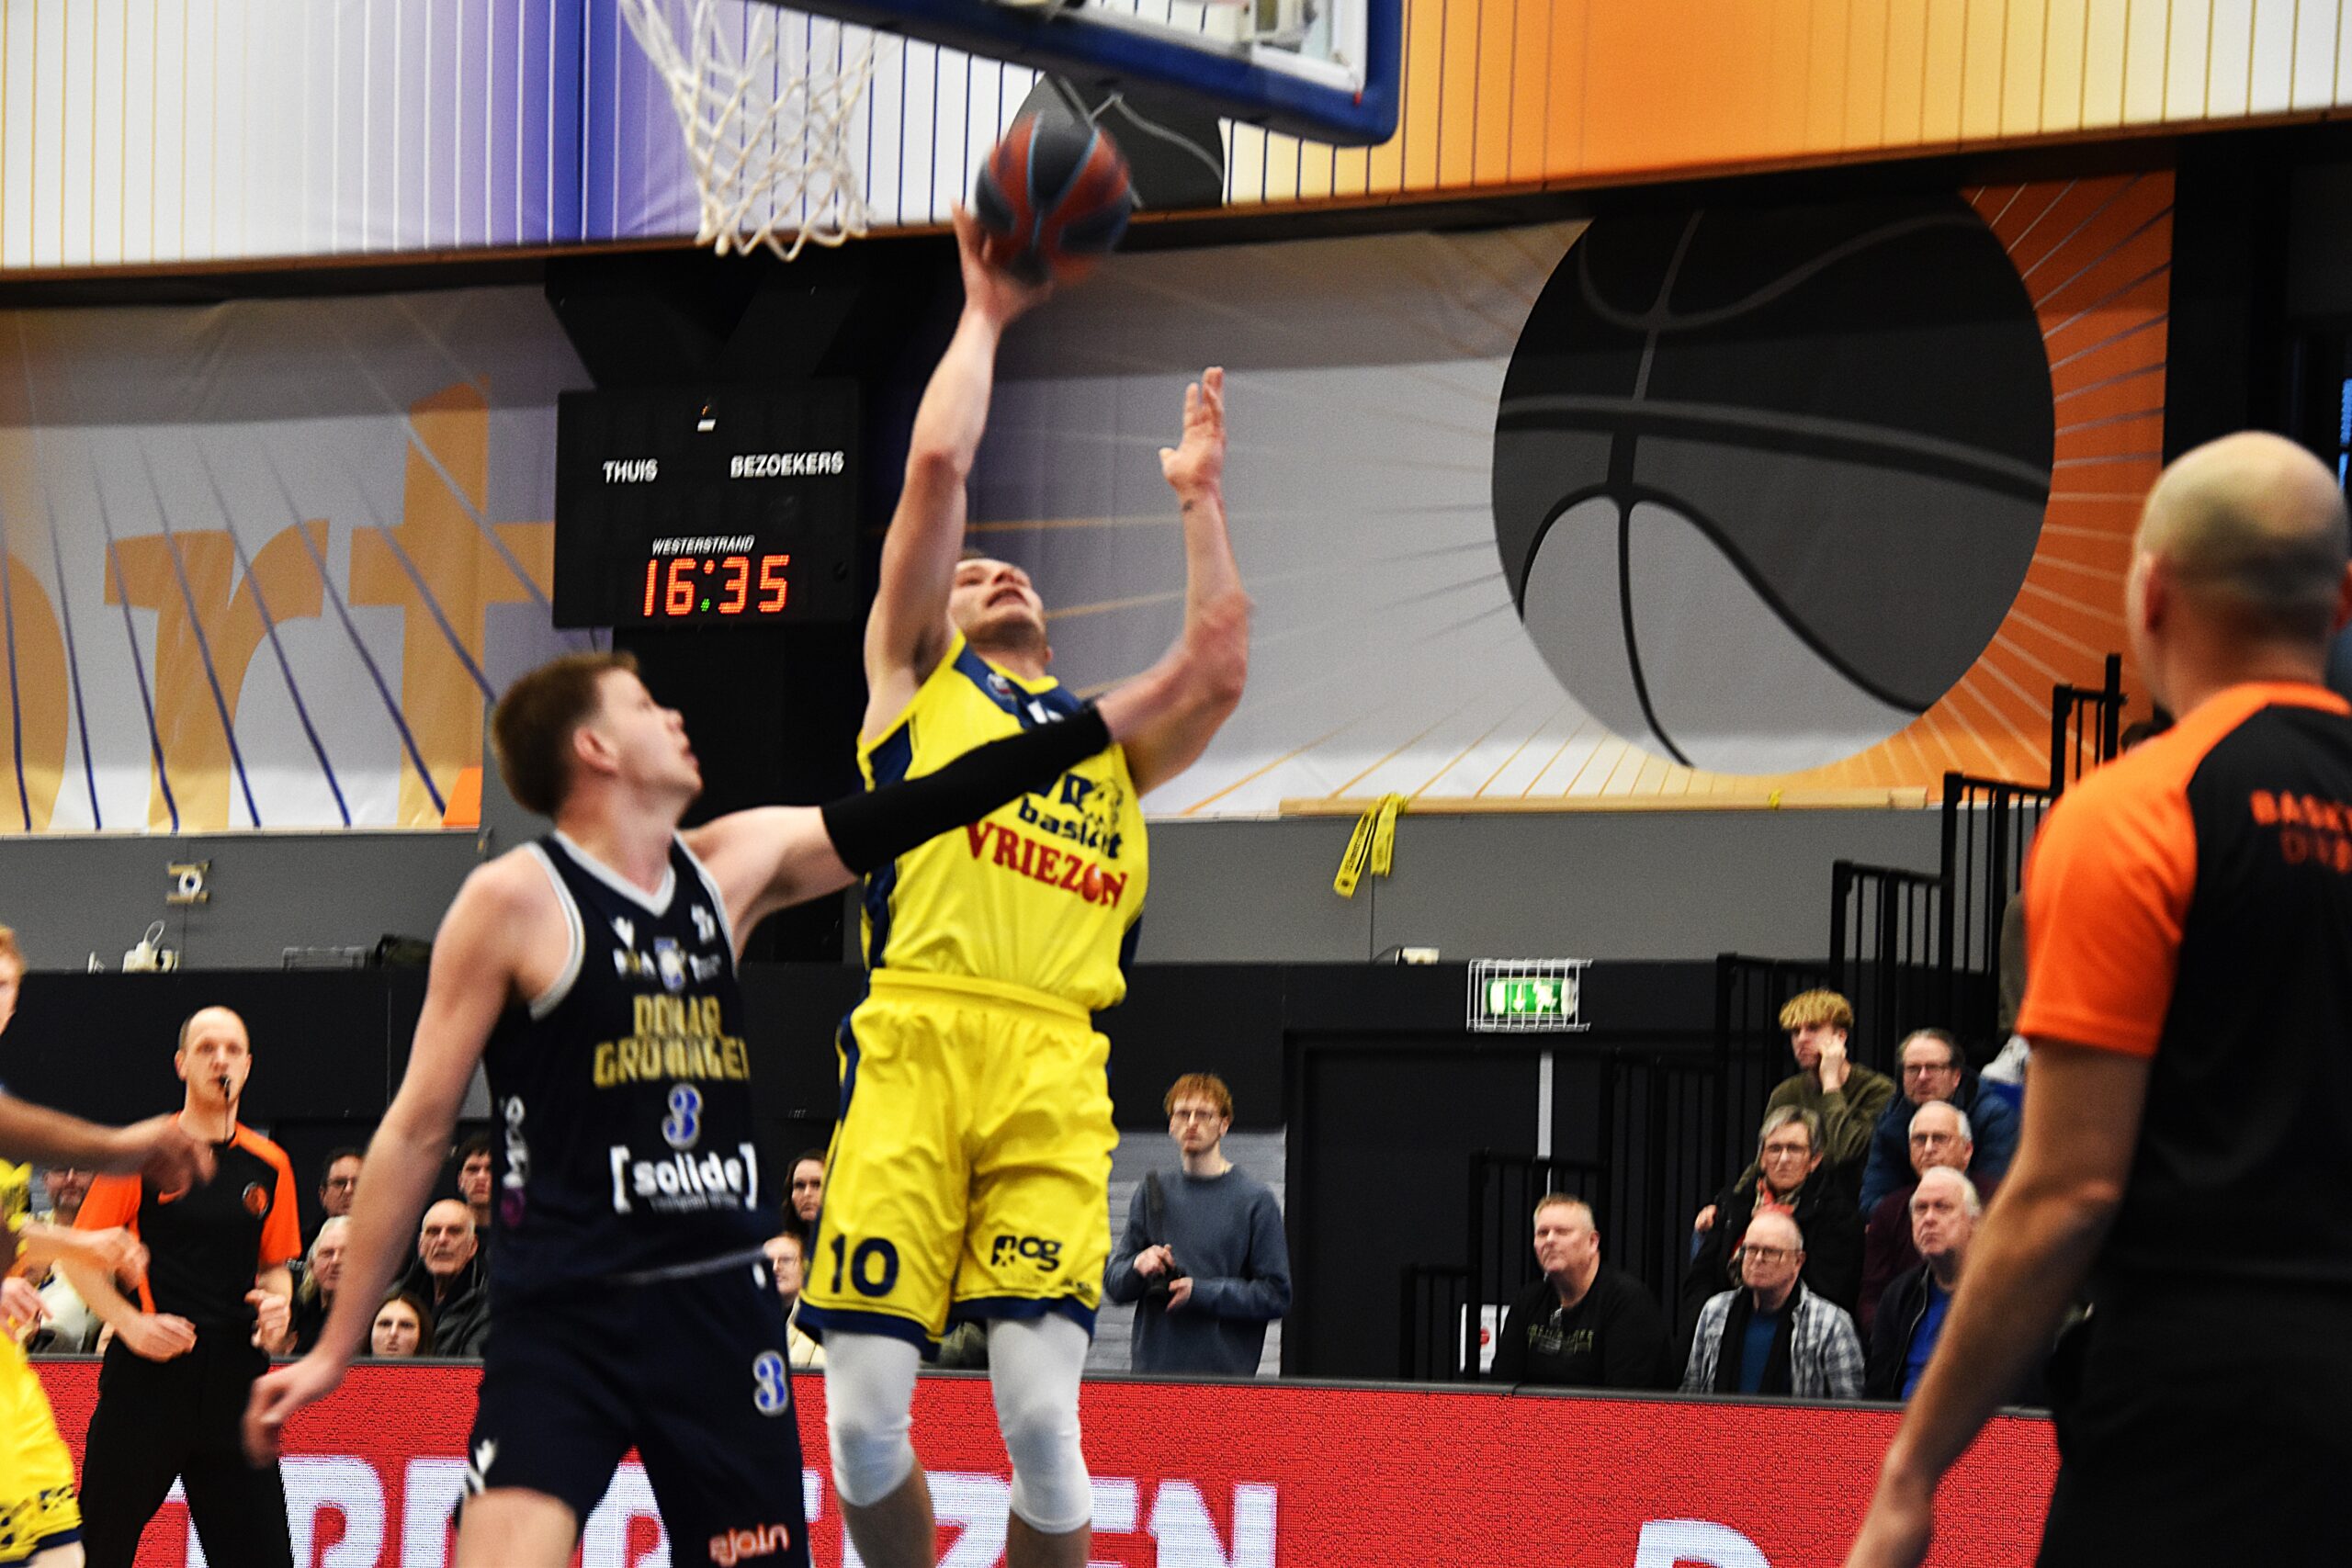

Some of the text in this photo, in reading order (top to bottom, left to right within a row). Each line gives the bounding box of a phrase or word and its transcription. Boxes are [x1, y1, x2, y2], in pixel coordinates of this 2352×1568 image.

[603, 458, 660, 484] THUIS
[729, 450, 846, 479] BEZOEKERS
[651, 535, 756, 557] WESTERSTRAND
[643, 554, 791, 617] 16:35
[967, 819, 1128, 908] VRIEZON
[662, 1082, 704, 1150] 3
[830, 1233, 900, 1299] 10
[752, 1349, 789, 1416] 3
